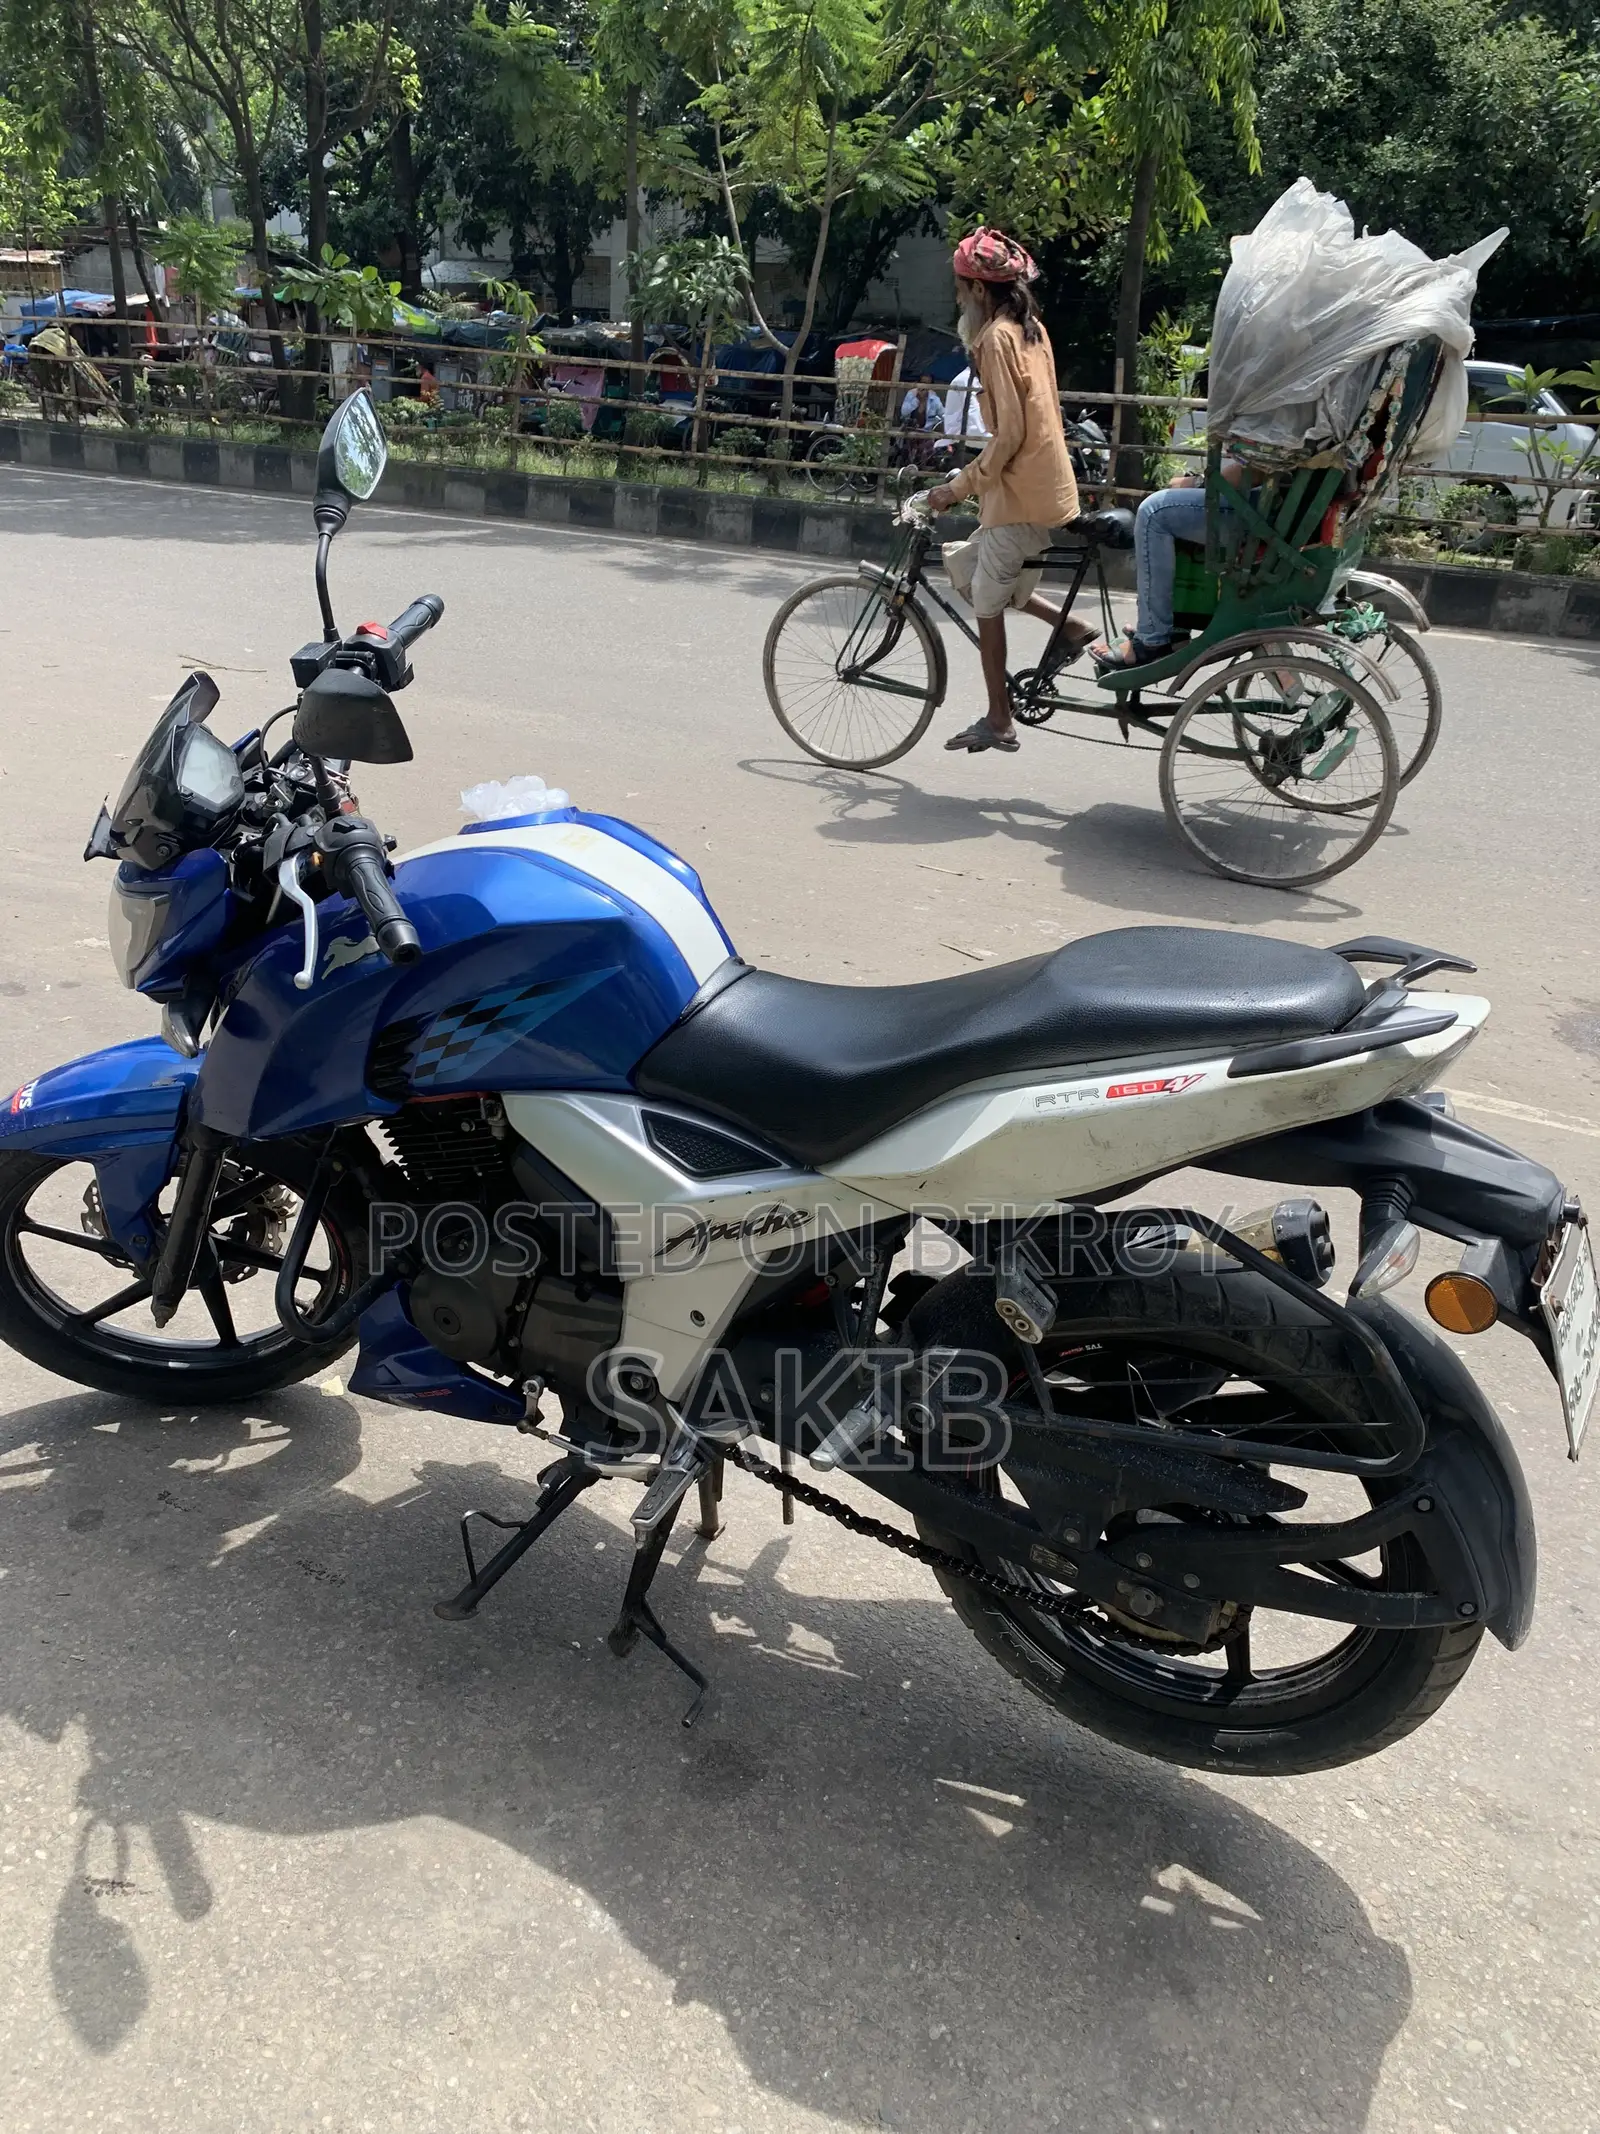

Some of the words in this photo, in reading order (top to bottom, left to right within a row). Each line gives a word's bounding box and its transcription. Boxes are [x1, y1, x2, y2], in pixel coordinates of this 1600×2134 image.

[19, 1079, 40, 1110] TVS
[1035, 1087, 1100, 1107] RTR
[651, 1198, 819, 1257] Apache
[1085, 1343, 1103, 1351] TVS
